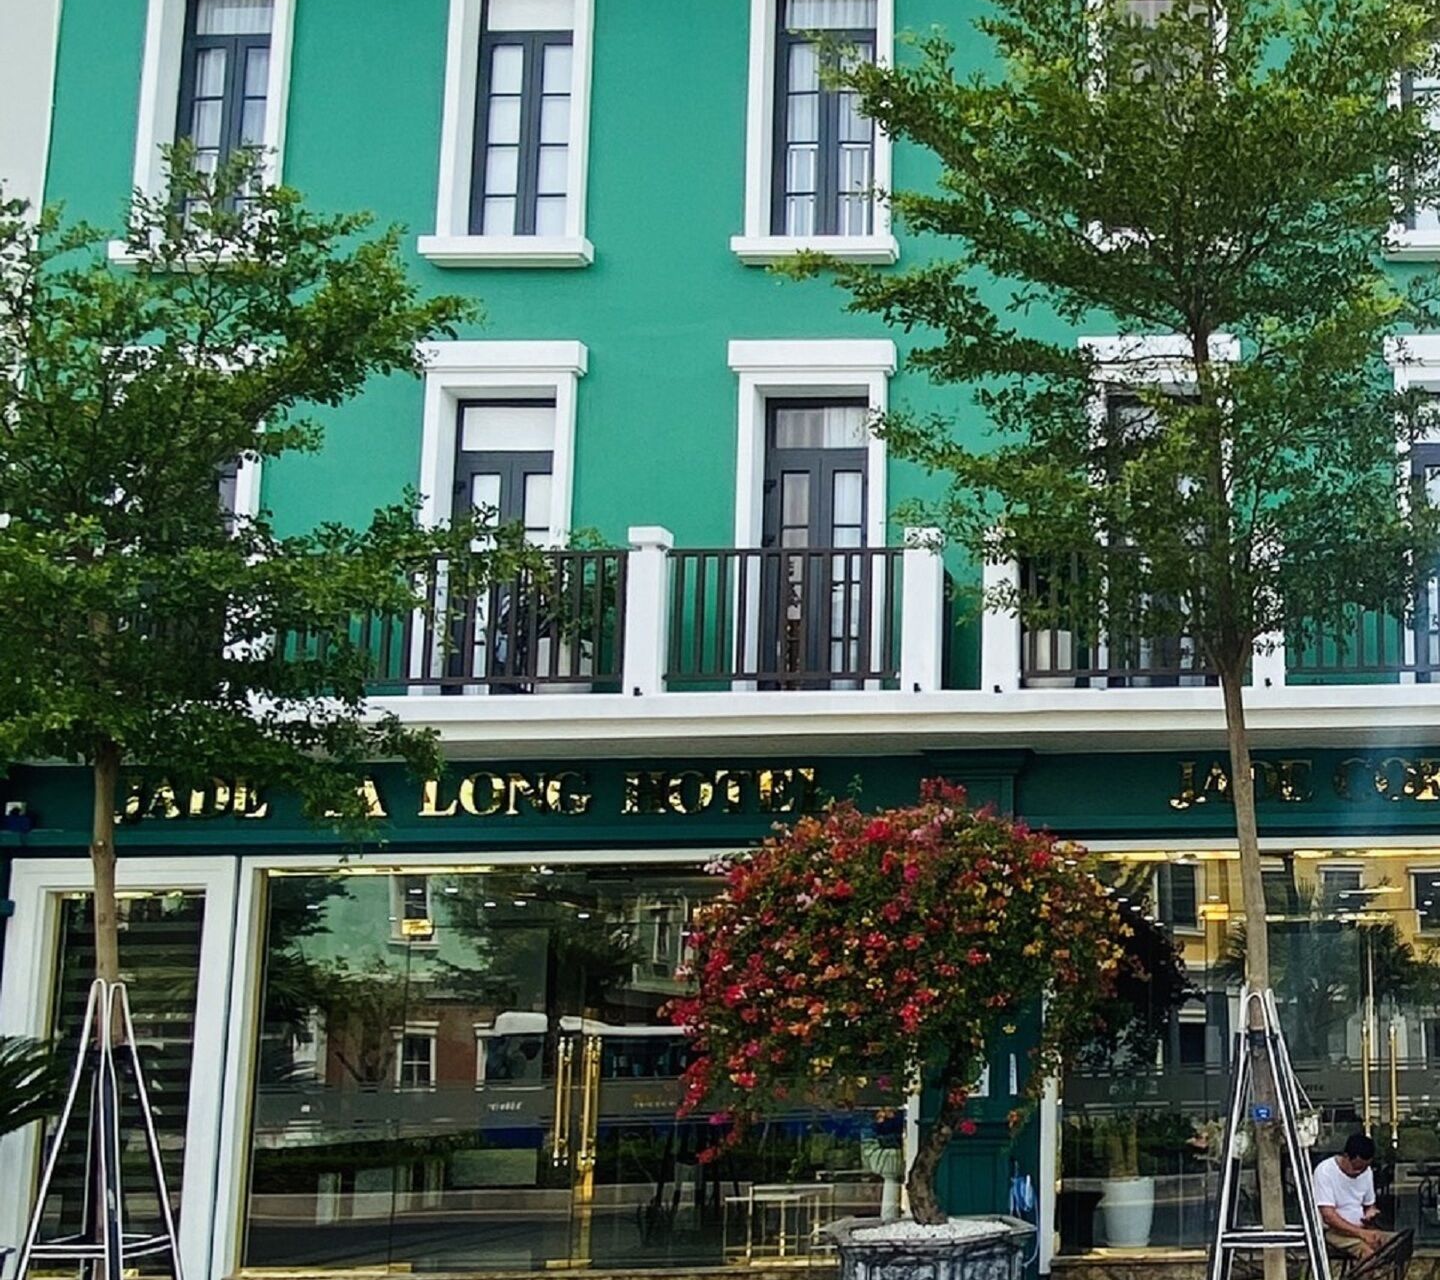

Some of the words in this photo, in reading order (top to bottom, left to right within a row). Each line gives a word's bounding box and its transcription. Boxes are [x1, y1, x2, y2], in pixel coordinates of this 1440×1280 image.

[113, 775, 269, 824] JADE
[418, 770, 593, 817] LONG
[621, 767, 832, 815] HOTEL
[1170, 759, 1314, 809] JADE
